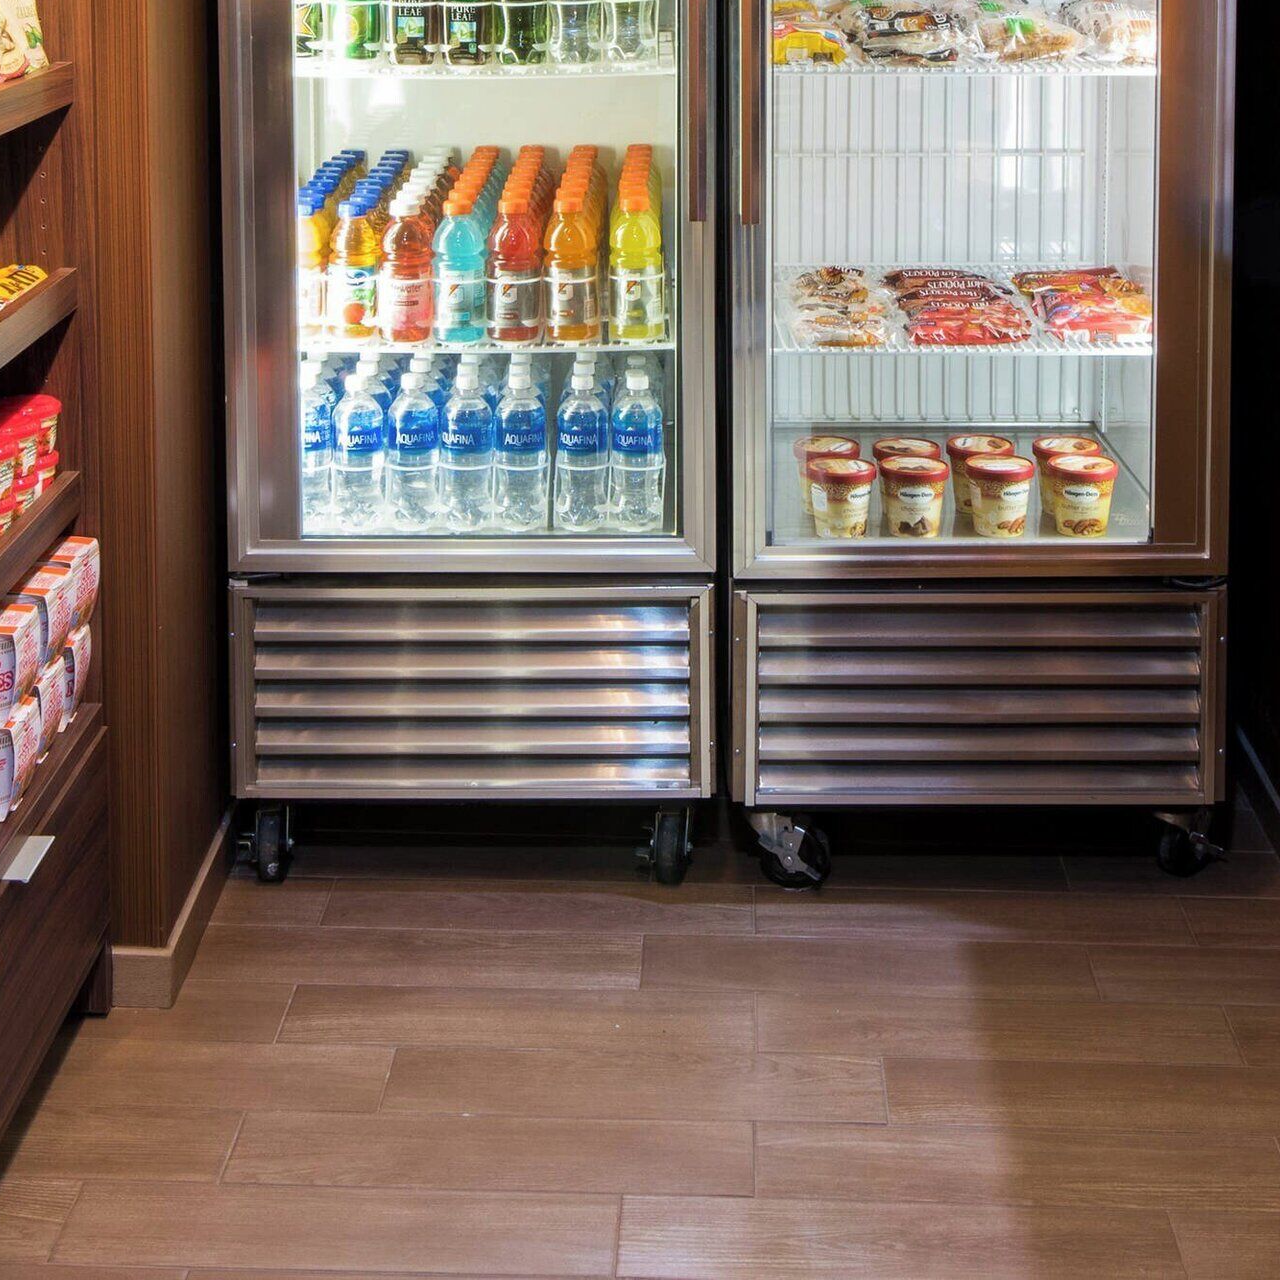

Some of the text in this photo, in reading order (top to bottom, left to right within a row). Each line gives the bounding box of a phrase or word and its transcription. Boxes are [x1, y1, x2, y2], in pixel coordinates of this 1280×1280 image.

[928, 281, 966, 289] POCKETS
[396, 432, 436, 448] AQUAFINA
[504, 432, 543, 448] AQUAFINA
[560, 432, 599, 447] AQUAFINA
